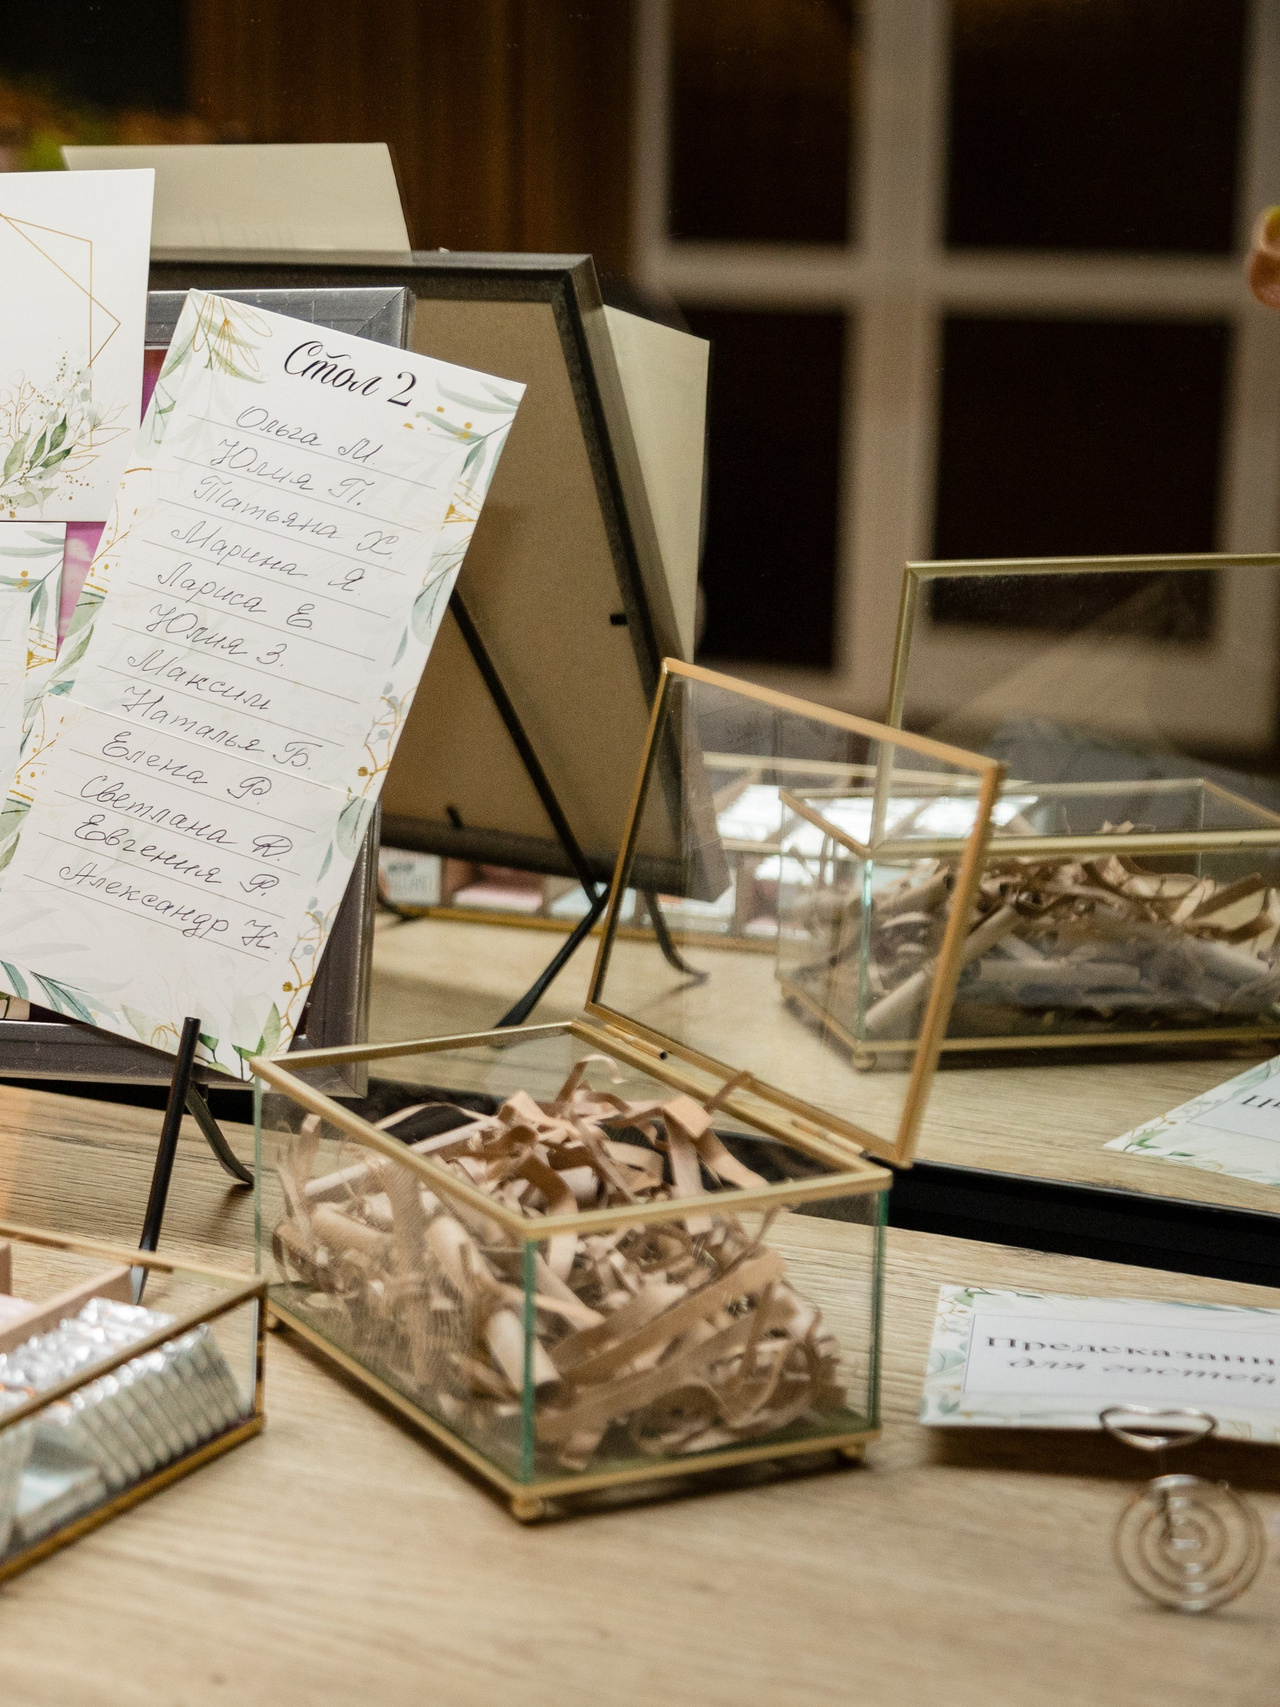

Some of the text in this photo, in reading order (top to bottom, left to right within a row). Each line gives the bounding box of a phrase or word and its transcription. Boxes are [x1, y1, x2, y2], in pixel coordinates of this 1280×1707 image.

[283, 340, 417, 407] Стол 2
[210, 438, 314, 490] Юлия
[236, 405, 385, 466] Ольга М.
[193, 475, 399, 560] Татьяна Х.
[170, 520, 366, 596] Марина Я.
[146, 603, 248, 656] Юлия
[157, 562, 316, 631] Лариса Е.
[127, 649, 272, 710] Максим
[101, 731, 208, 785] Елена
[121, 685, 324, 771] Наталья Б.
[80, 775, 237, 846] Светлана
[74, 814, 222, 885] Евгения
[59, 862, 229, 938] Александр
[1009, 1357, 1277, 1385] для гостей
